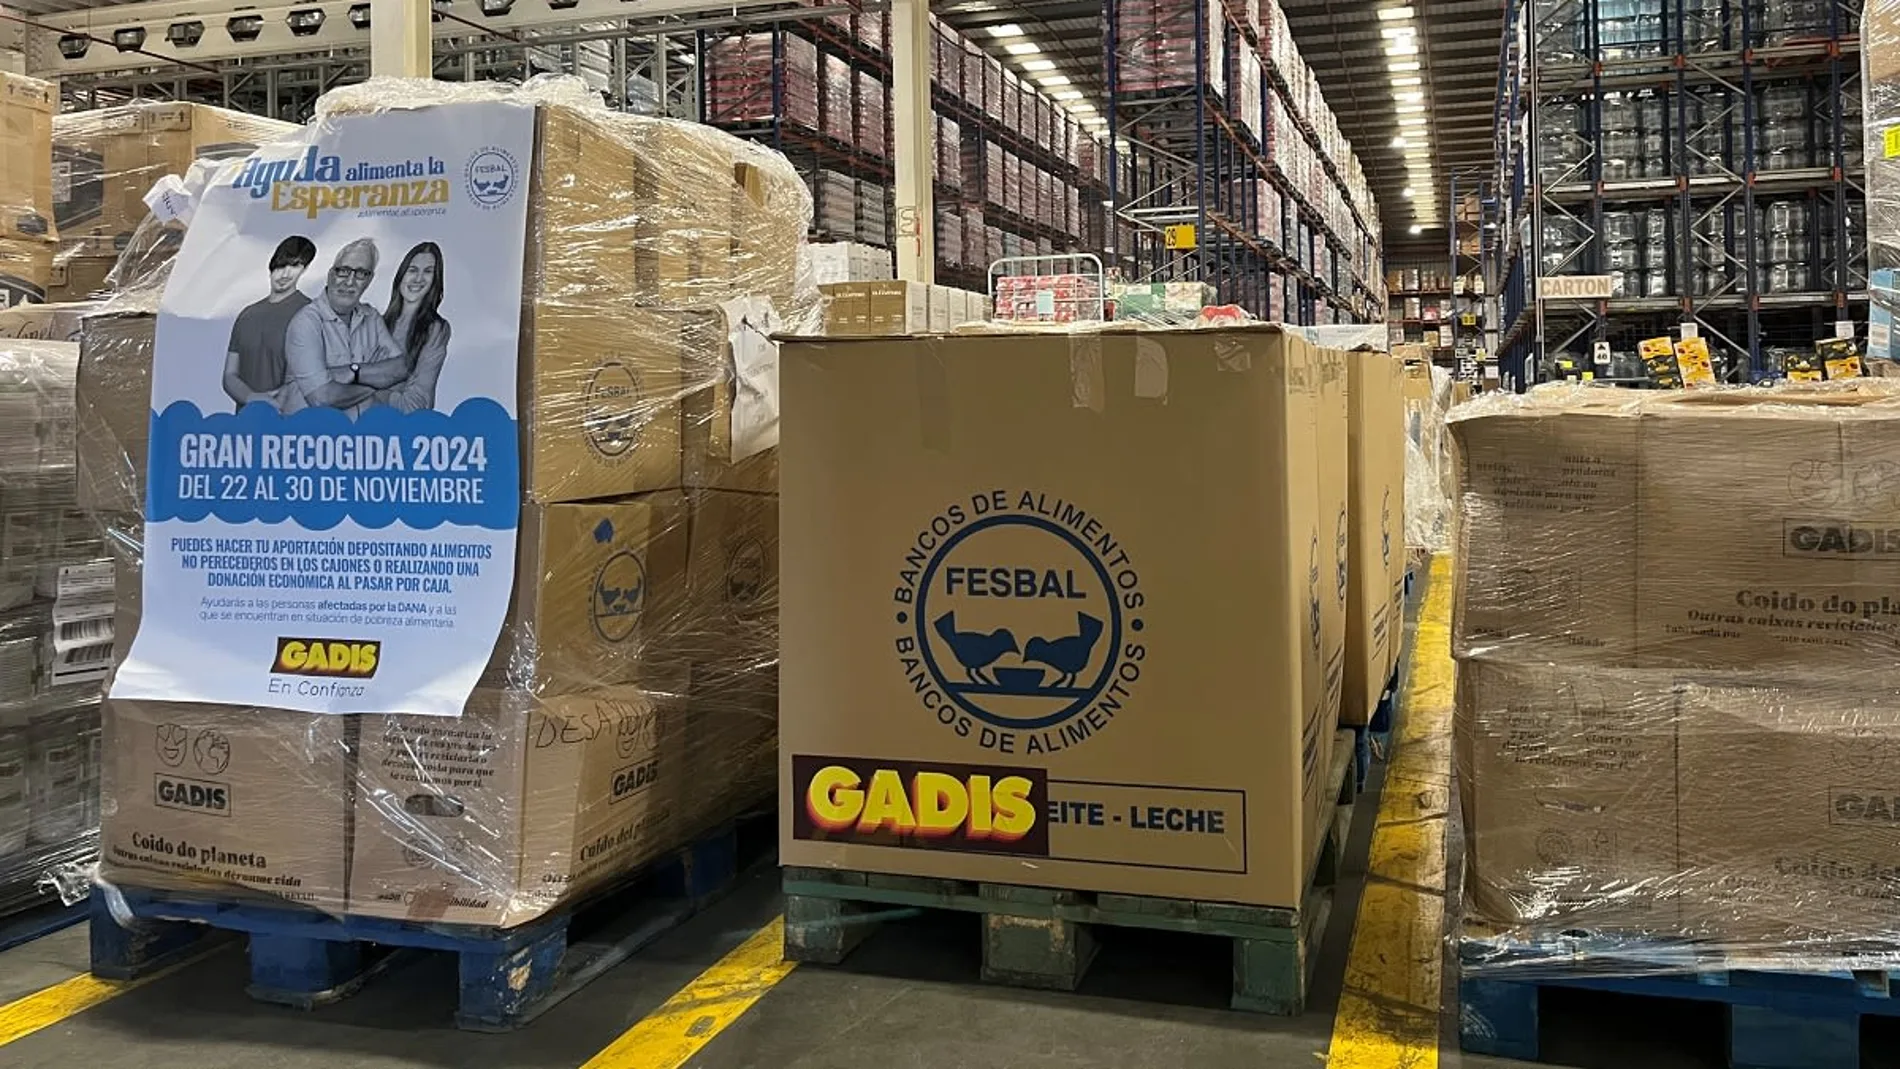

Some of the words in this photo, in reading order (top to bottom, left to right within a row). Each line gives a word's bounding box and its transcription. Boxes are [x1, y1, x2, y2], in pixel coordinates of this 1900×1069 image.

[232, 145, 341, 198] Ayuda
[345, 160, 423, 181] alimenta
[428, 156, 445, 175] la
[475, 164, 508, 174] FESBAL
[271, 178, 450, 219] Esperanza
[1541, 279, 1609, 296] CARTON
[179, 434, 252, 469] GRAN
[261, 435, 405, 471] RECOGIDA
[412, 436, 487, 472] 2024
[178, 474, 215, 500] DEL
[220, 475, 248, 500] 22
[254, 476, 280, 501] AL
[285, 476, 313, 501] 30
[320, 477, 348, 502] DE
[354, 477, 485, 505] NOVIEMBRE
[171, 537, 213, 552] PUEDES
[216, 539, 253, 553] HACER
[255, 539, 270, 553] TU
[272, 537, 345, 556] APORTACIÓN
[348, 541, 427, 557] DEPOSITANDO
[430, 543, 492, 559] ALIMENTOS
[895, 504, 966, 604] BANCOS
[971, 490, 1008, 515] DE
[1018, 490, 1145, 609] ALIMENTOS
[181, 555, 197, 569] NO
[200, 555, 278, 571] PERECEDEROS
[281, 557, 294, 571] EN
[297, 558, 318, 572] LOS
[321, 558, 371, 573] CAJONES
[373, 559, 382, 574] O
[385, 560, 454, 575] REALIZANDO
[456, 562, 479, 577] UNA
[208, 570, 265, 588] DONACIÓN
[268, 571, 333, 589] ECONÓMICA
[337, 576, 351, 590] AL
[354, 576, 393, 591] PASAR
[396, 577, 420, 592] POR
[423, 578, 452, 593] CAJA.
[946, 567, 1087, 599] FESBAL
[199, 610, 218, 621] que
[220, 612, 232, 620] se
[234, 611, 289, 621] encuentran
[291, 612, 303, 621] en
[305, 611, 348, 623] situación
[350, 614, 363, 624] de
[365, 614, 403, 626] pobreza
[200, 597, 246, 609] Ayudarás
[246, 599, 254, 607] a
[256, 598, 269, 608] las
[271, 600, 316, 610] personas
[318, 600, 368, 611] afectadas
[369, 602, 385, 613] por
[387, 602, 397, 612] la
[398, 602, 427, 613] DANA
[428, 606, 434, 616] y
[435, 606, 442, 614] a
[444, 605, 457, 615] las
[1688, 609, 1744, 625] Outras
[1735, 590, 1816, 612] Coido
[1822, 594, 1857, 615] do
[281, 641, 378, 674] GADIS
[268, 678, 291, 694] En
[297, 680, 365, 698] Confianza
[895, 636, 972, 737] BANCOS
[979, 728, 1015, 754] DE
[1026, 643, 1146, 755] ALIMENTOS
[613, 759, 660, 797] GADIS
[158, 779, 227, 811] GADIS
[807, 766, 1038, 843] GADIS
[1835, 794, 1900, 820] GA
[1048, 800, 1104, 827] EITE
[1130, 806, 1225, 835] LECHE
[132, 831, 174, 855] Coido
[177, 840, 197, 860] do
[200, 846, 267, 869] planeta
[274, 874, 302, 887] vida
